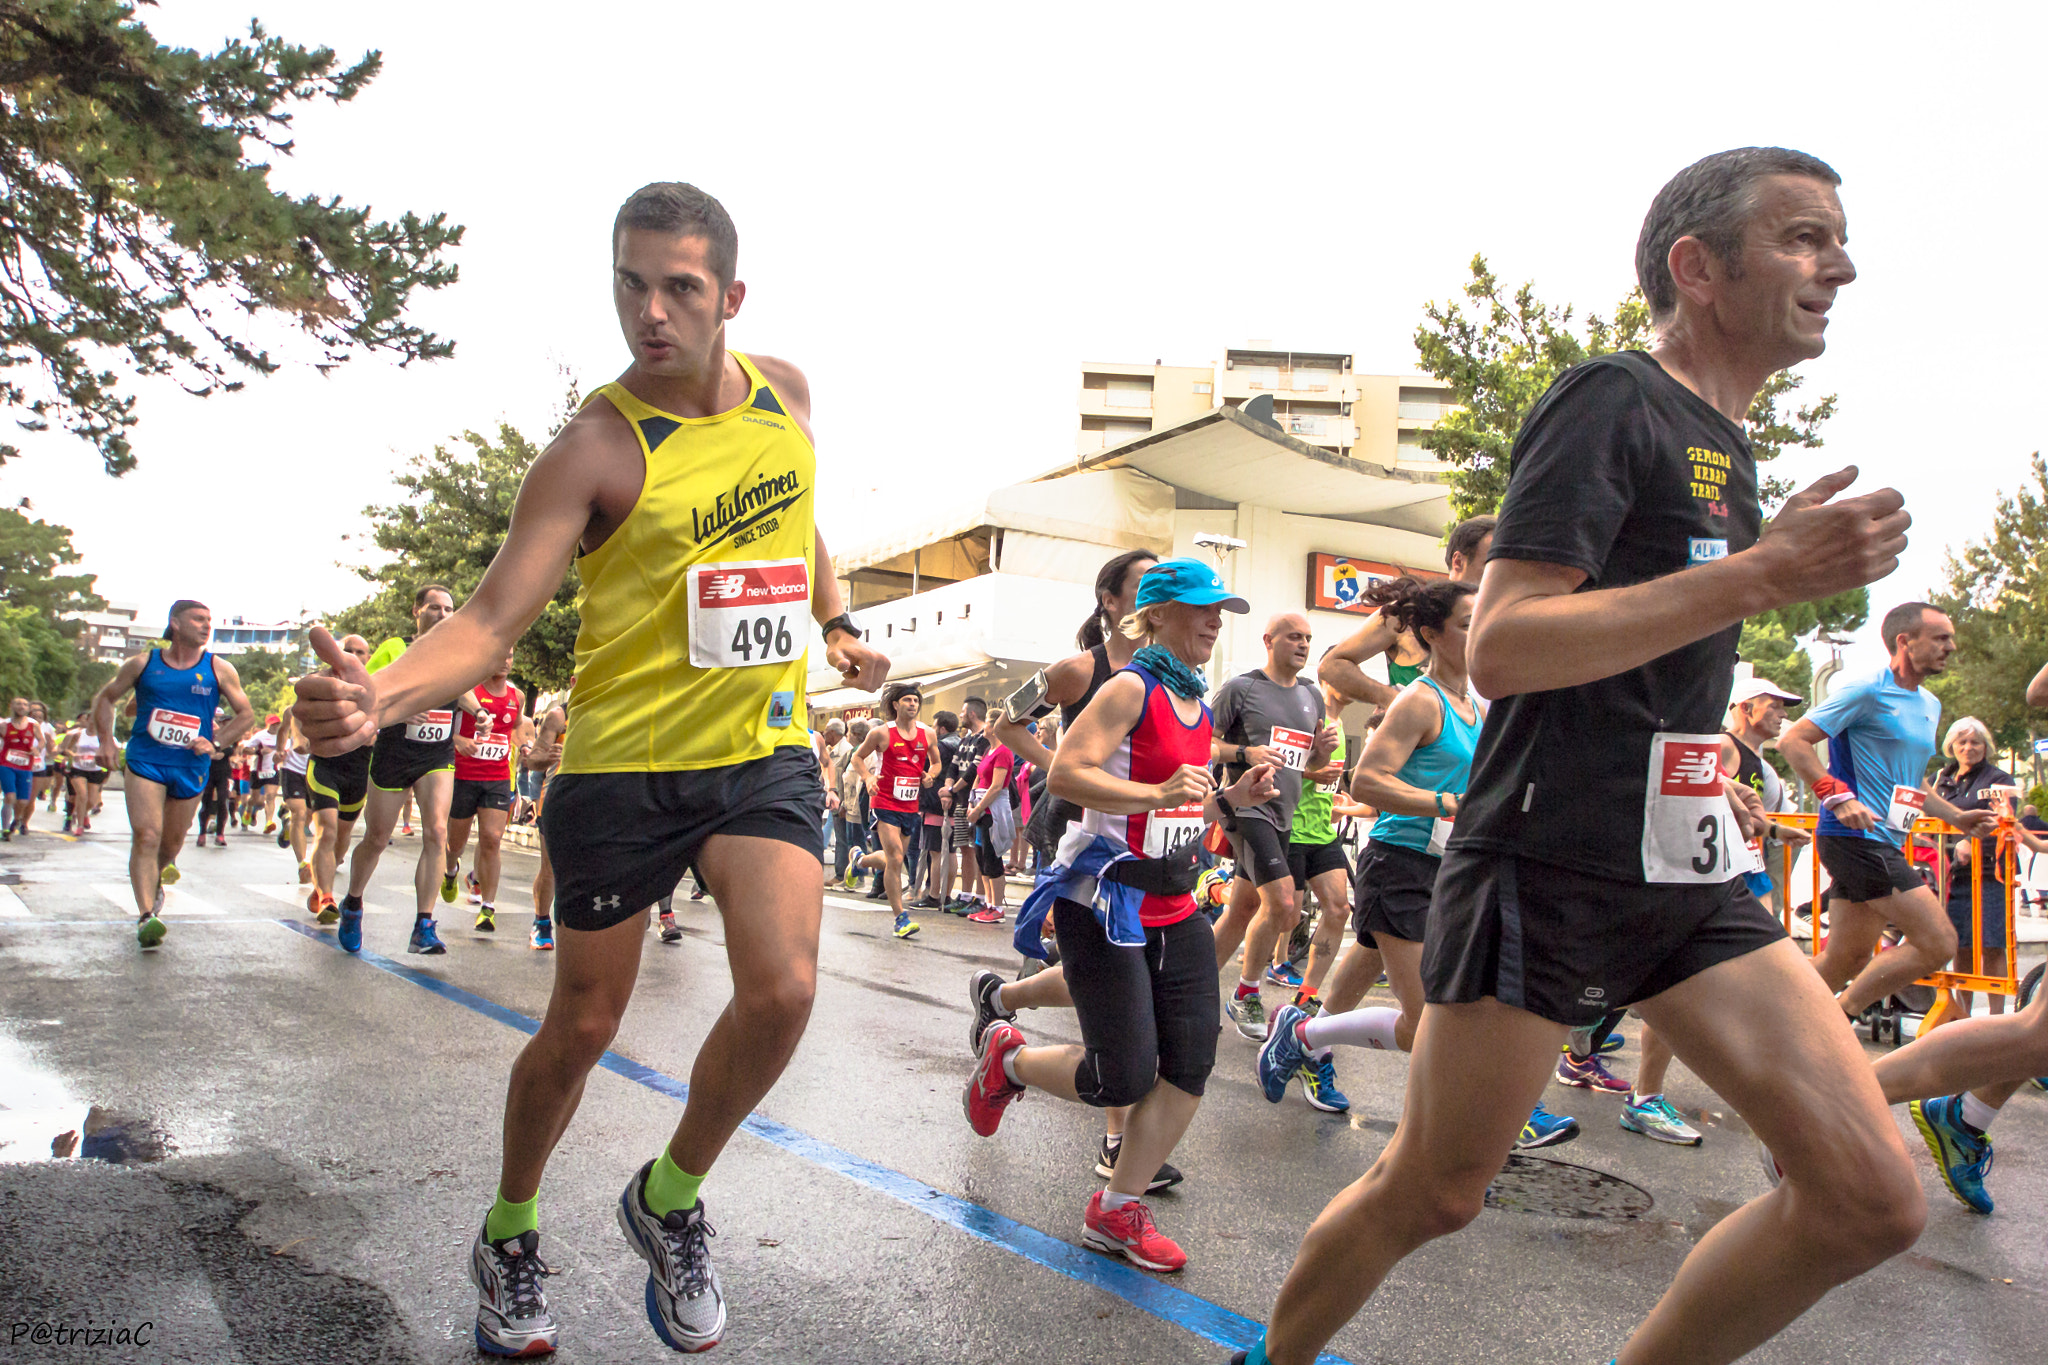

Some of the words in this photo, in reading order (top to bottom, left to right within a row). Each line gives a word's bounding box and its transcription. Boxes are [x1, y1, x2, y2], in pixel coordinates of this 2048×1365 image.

[742, 415, 786, 431] DIADORA
[1693, 465, 1727, 485] URBAN
[1690, 482, 1720, 501] TRAIL
[734, 531, 757, 549] SINCE
[756, 517, 780, 537] 2008
[746, 588, 768, 597] new
[770, 583, 806, 596] balance
[731, 615, 792, 661] 496
[158, 726, 191, 744] 1306
[418, 726, 443, 740] 650
[480, 746, 505, 759] 1475
